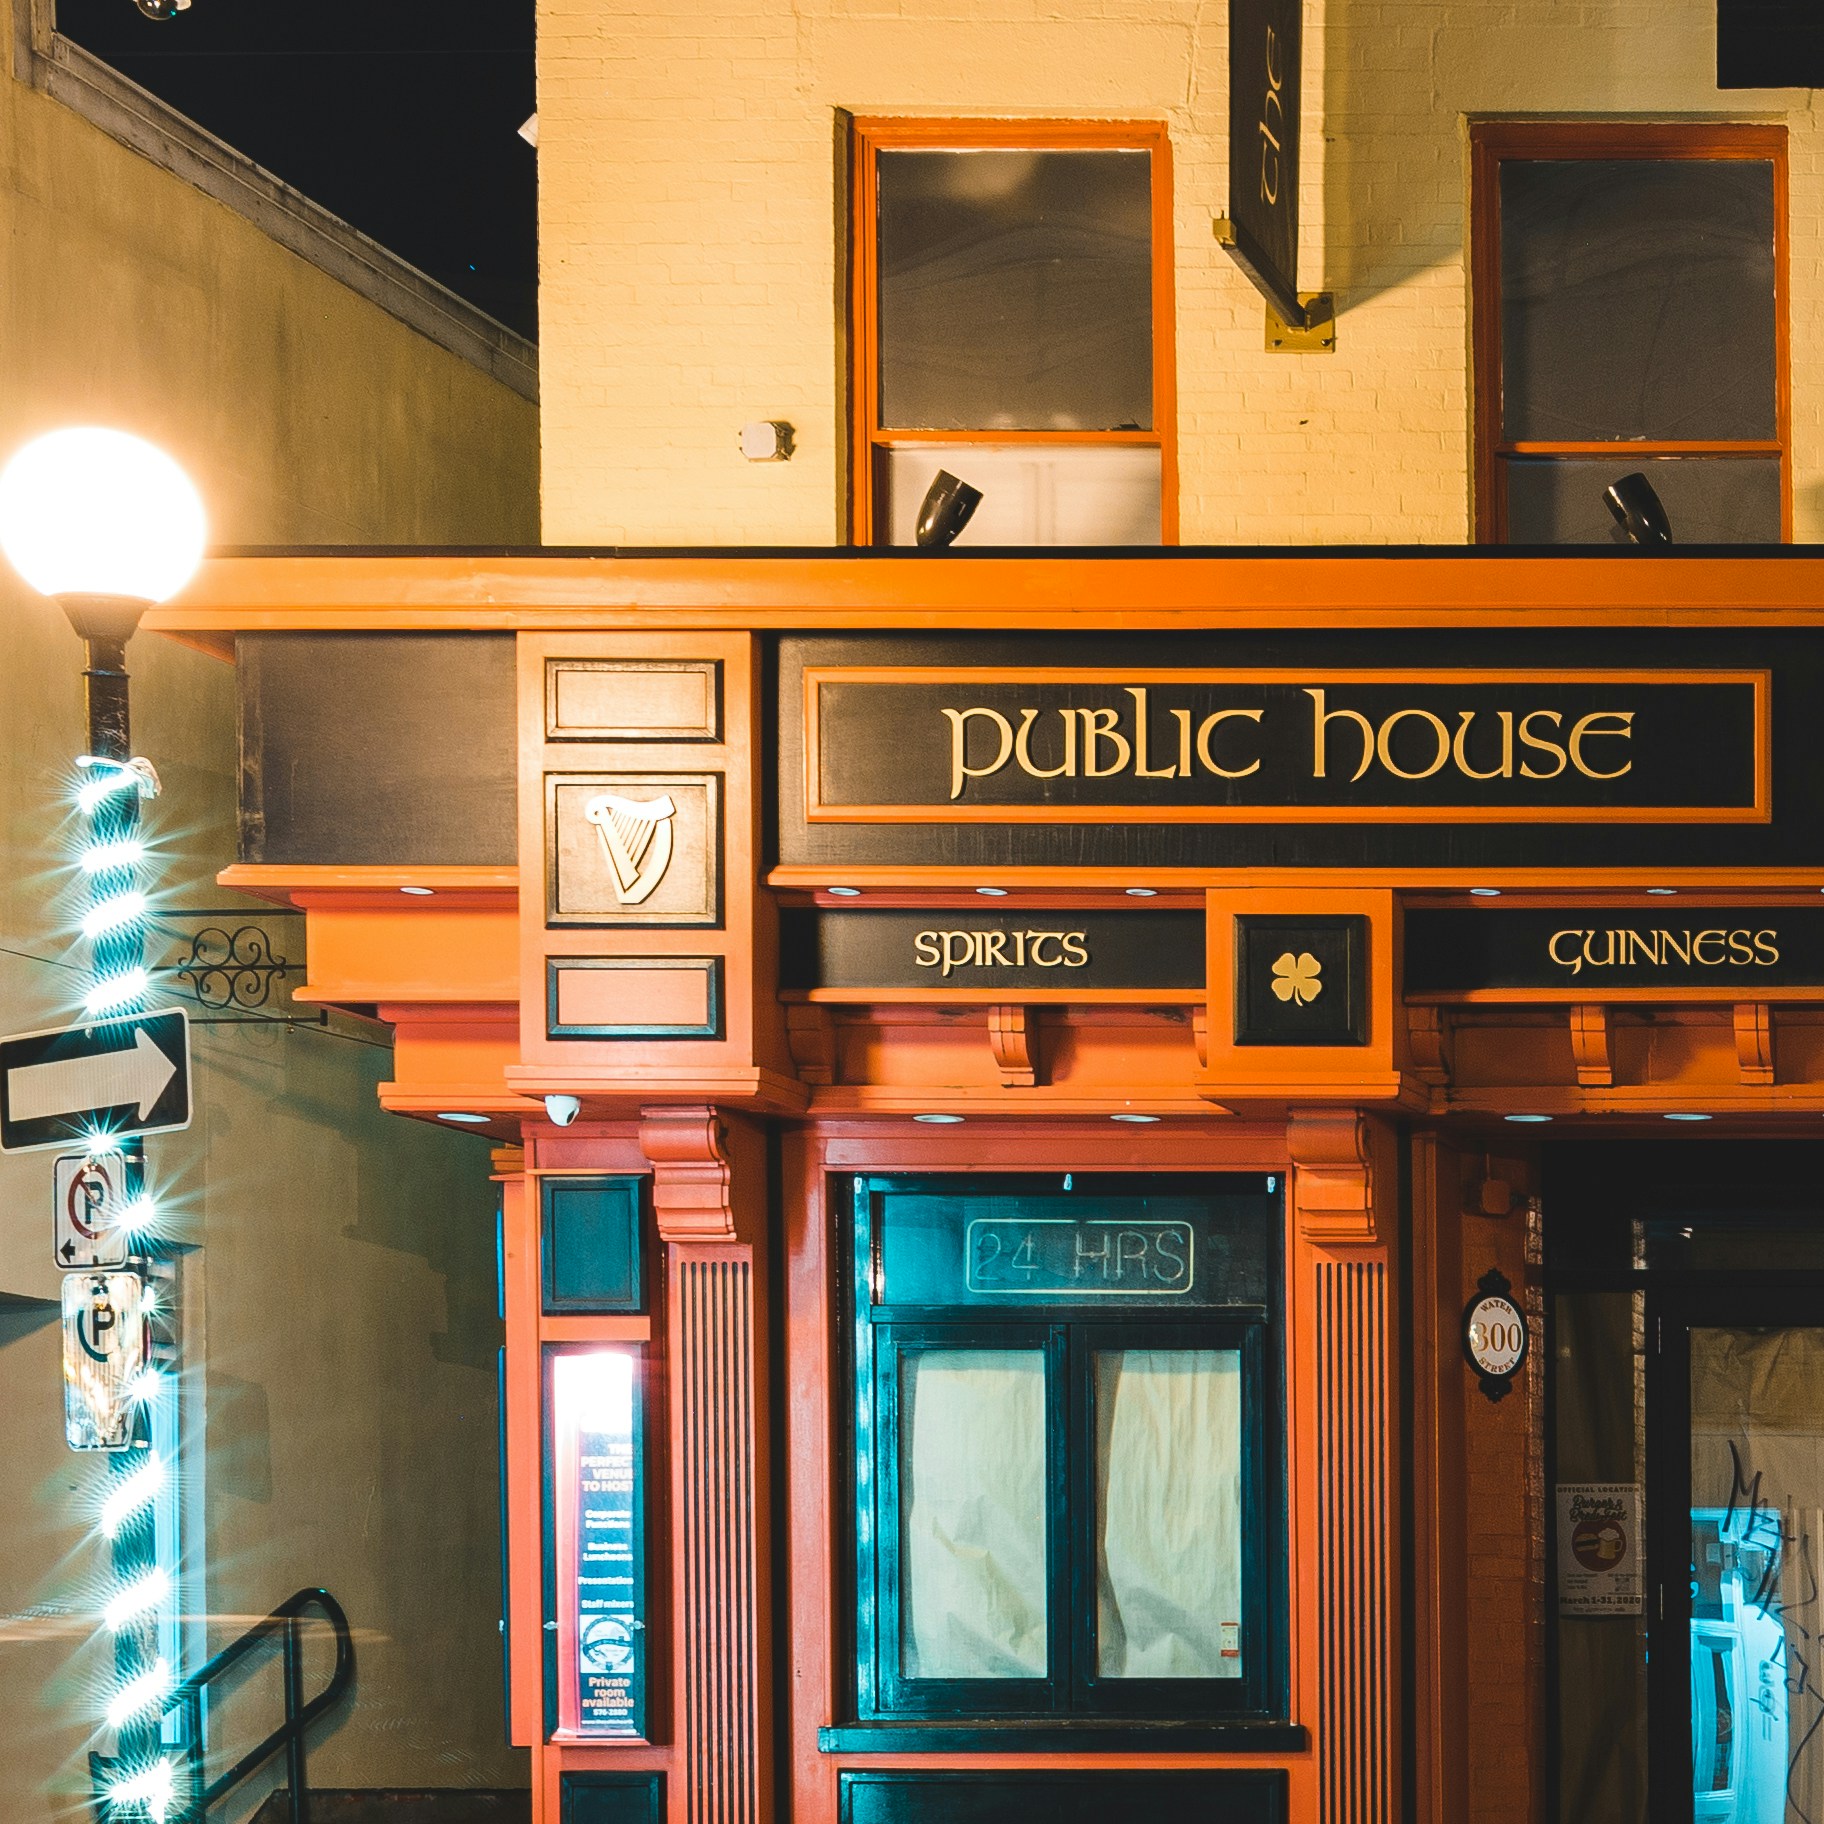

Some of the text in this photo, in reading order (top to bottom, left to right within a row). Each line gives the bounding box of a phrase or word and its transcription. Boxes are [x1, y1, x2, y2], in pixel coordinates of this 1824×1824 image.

[940, 687, 1636, 800] PUBLIC HOUSE
[914, 930, 1089, 977] SPIRITS
[1548, 929, 1780, 976] GUINNESS
[975, 1229, 1185, 1281] 24 HRS
[1479, 1299, 1513, 1315] WATER
[1472, 1321, 1522, 1353] 300
[1478, 1356, 1516, 1374] STREET
[581, 1480, 600, 1492] TO
[1557, 1486, 1595, 1494] OFFICIAL
[1560, 1596, 1589, 1604] March
[1617, 1596, 1641, 1605] 2020
[588, 1676, 631, 1687] Private
[594, 1688, 626, 1698] room
[582, 1696, 634, 1708] available
